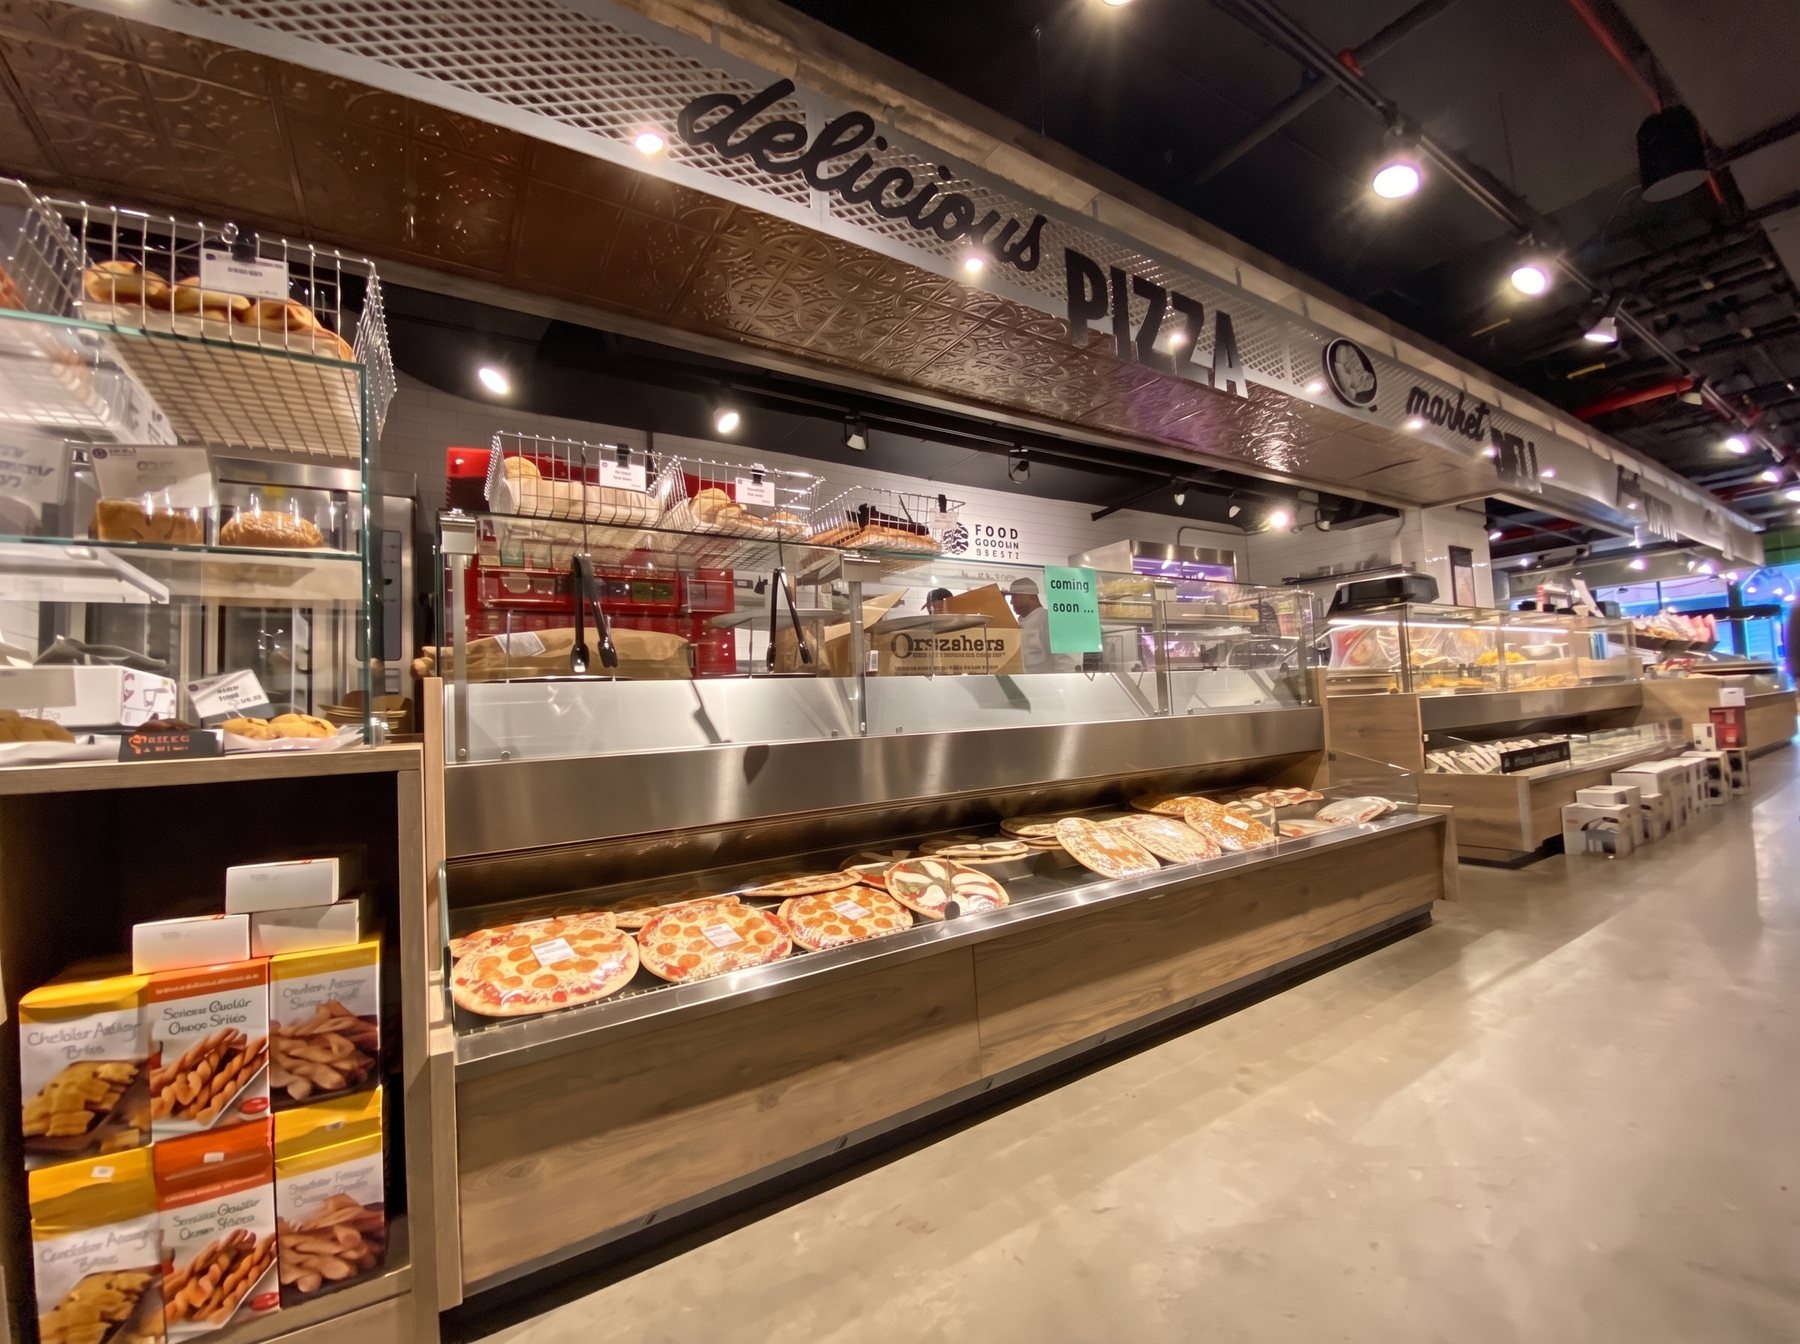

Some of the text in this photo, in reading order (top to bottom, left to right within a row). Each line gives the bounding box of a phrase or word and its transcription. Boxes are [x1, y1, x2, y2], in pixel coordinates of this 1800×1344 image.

[677, 78, 1249, 400] delicious PIZZA
[1405, 385, 1491, 442] market
[975, 524, 1019, 540] FOOD
[1050, 578, 1090, 594] coming
